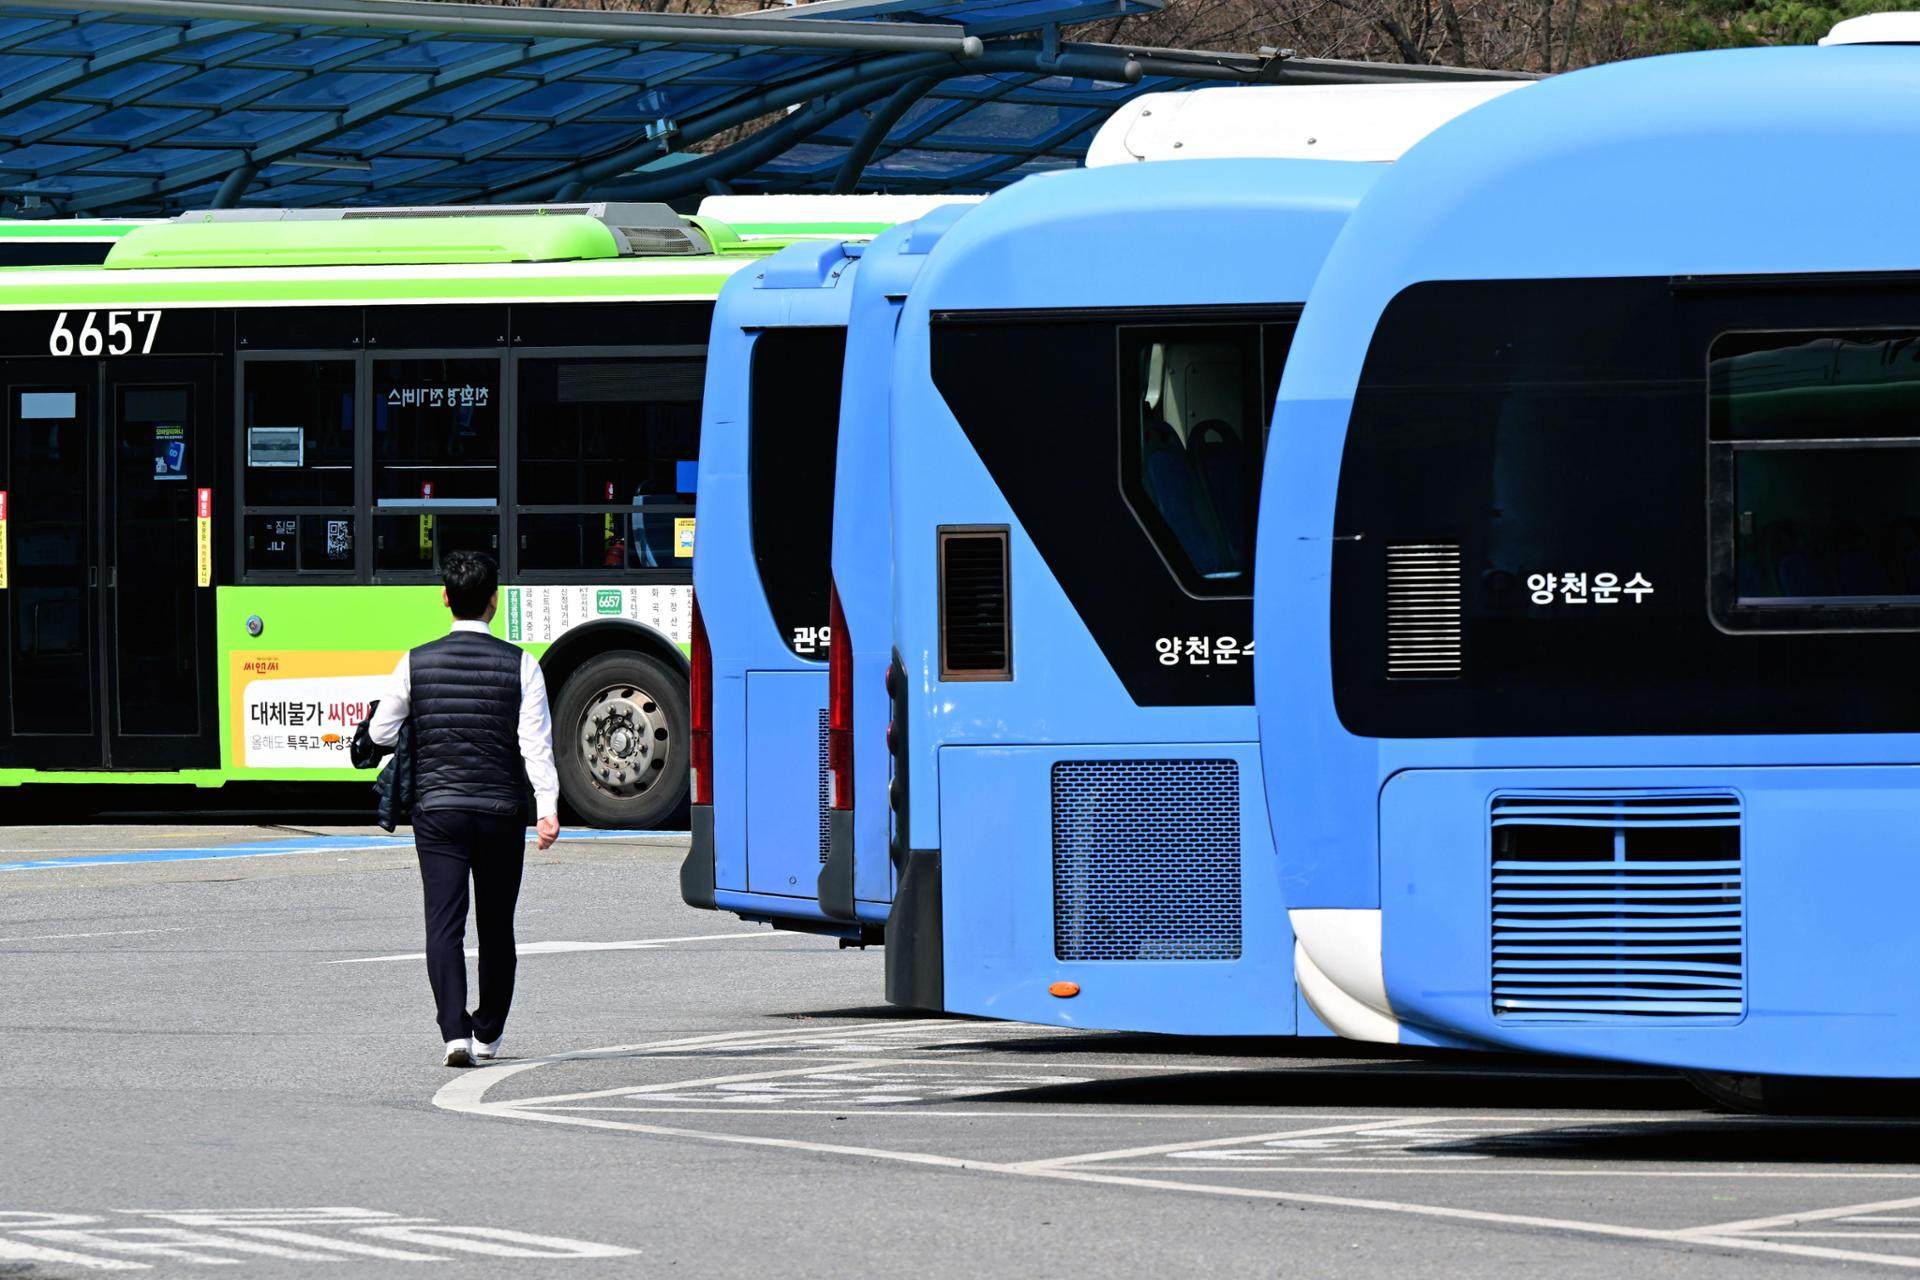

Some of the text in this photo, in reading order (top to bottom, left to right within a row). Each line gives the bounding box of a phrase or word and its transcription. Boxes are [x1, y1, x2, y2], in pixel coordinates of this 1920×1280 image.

[50, 310, 162, 356] 6657
[598, 595, 620, 608] 6657
[1527, 572, 1654, 605] 양천운수
[251, 701, 371, 727] 대체불가 씨앤
[252, 734, 285, 750] 올해도
[287, 734, 320, 750] 특목고
